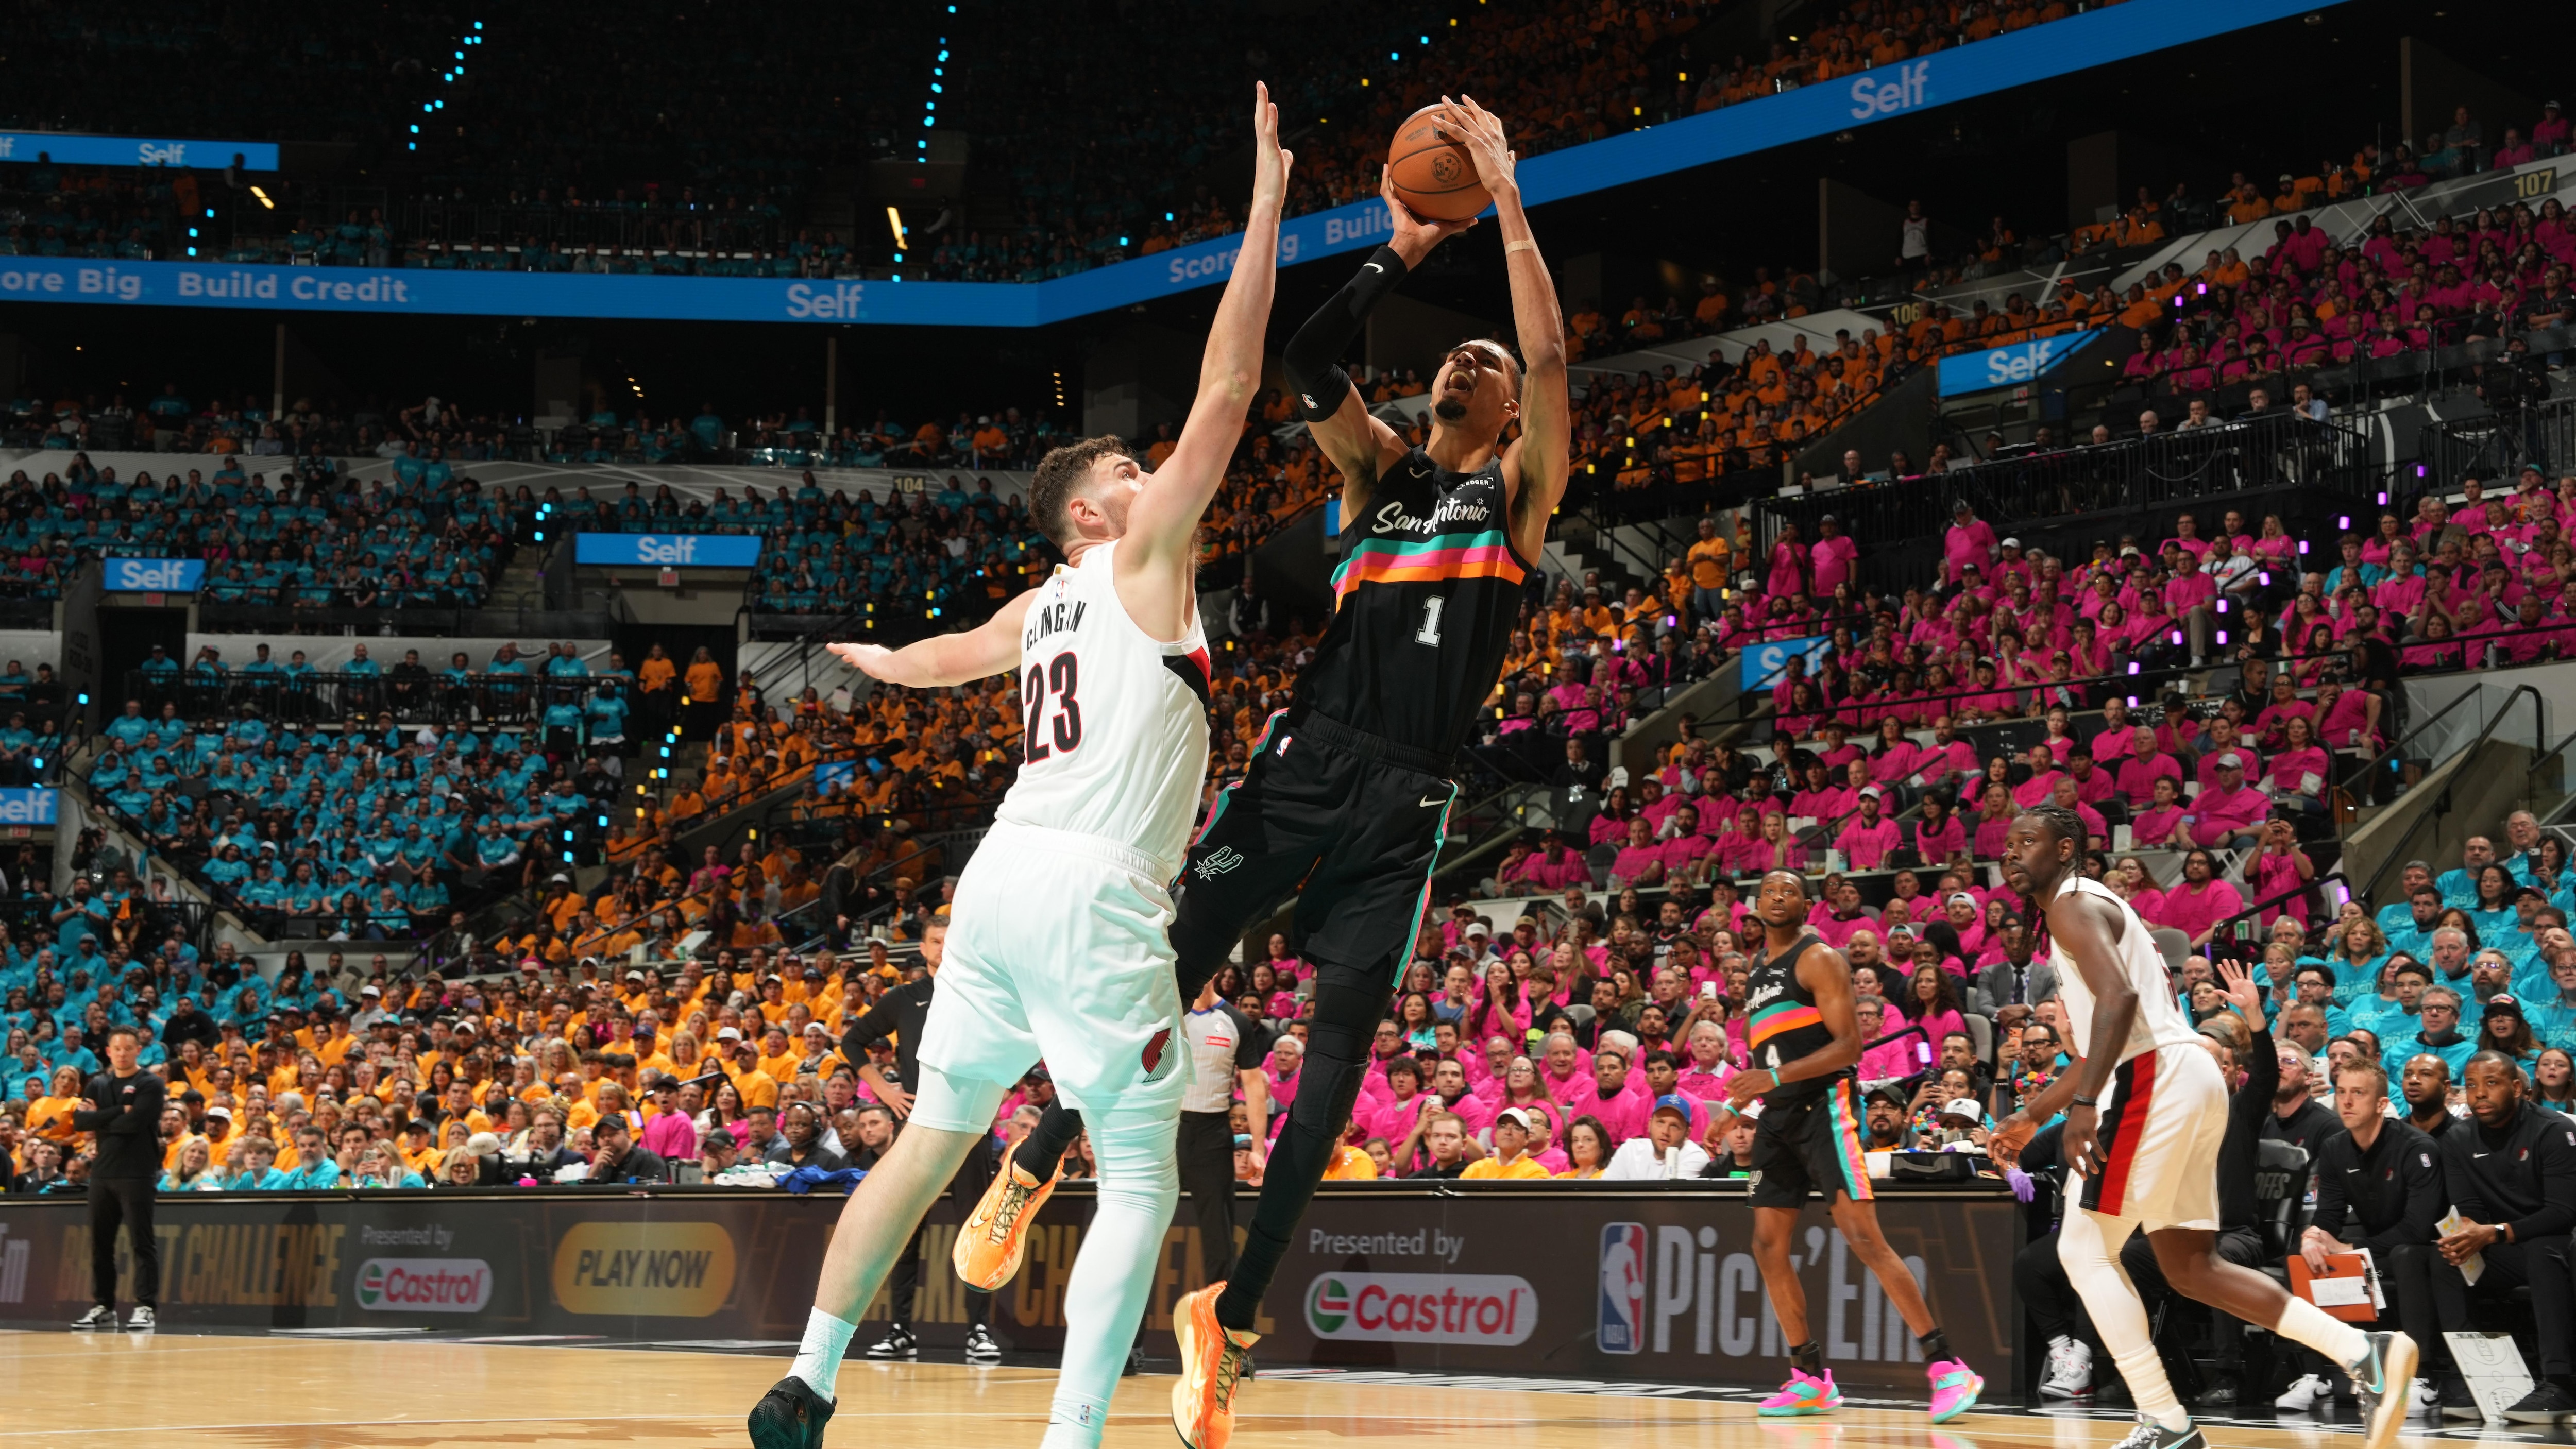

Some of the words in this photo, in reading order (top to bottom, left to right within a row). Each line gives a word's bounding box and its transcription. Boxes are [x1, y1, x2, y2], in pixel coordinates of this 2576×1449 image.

[2514, 169, 2553, 198] 107
[178, 271, 278, 299] Build
[1891, 304, 1921, 325] 106
[895, 477, 925, 493] 104
[1372, 501, 1423, 534] San
[1422, 497, 1490, 535] Antonio
[1026, 600, 1087, 651] CLINGAN
[1415, 595, 1445, 647] 1
[1760, 640, 1833, 687] Slf
[1025, 651, 1082, 766] 23
[1766, 1044, 1782, 1068] 4
[361, 1223, 432, 1247] Presented
[434, 1224, 455, 1251] by
[1309, 1228, 1426, 1256] Presented
[1433, 1228, 1464, 1264] by
[181, 1223, 347, 1307] CHALLENGE
[574, 1249, 646, 1288] PLAY
[644, 1249, 714, 1289] NOW
[385, 1267, 482, 1305] Castrol
[1355, 1286, 1518, 1335] Castrol
